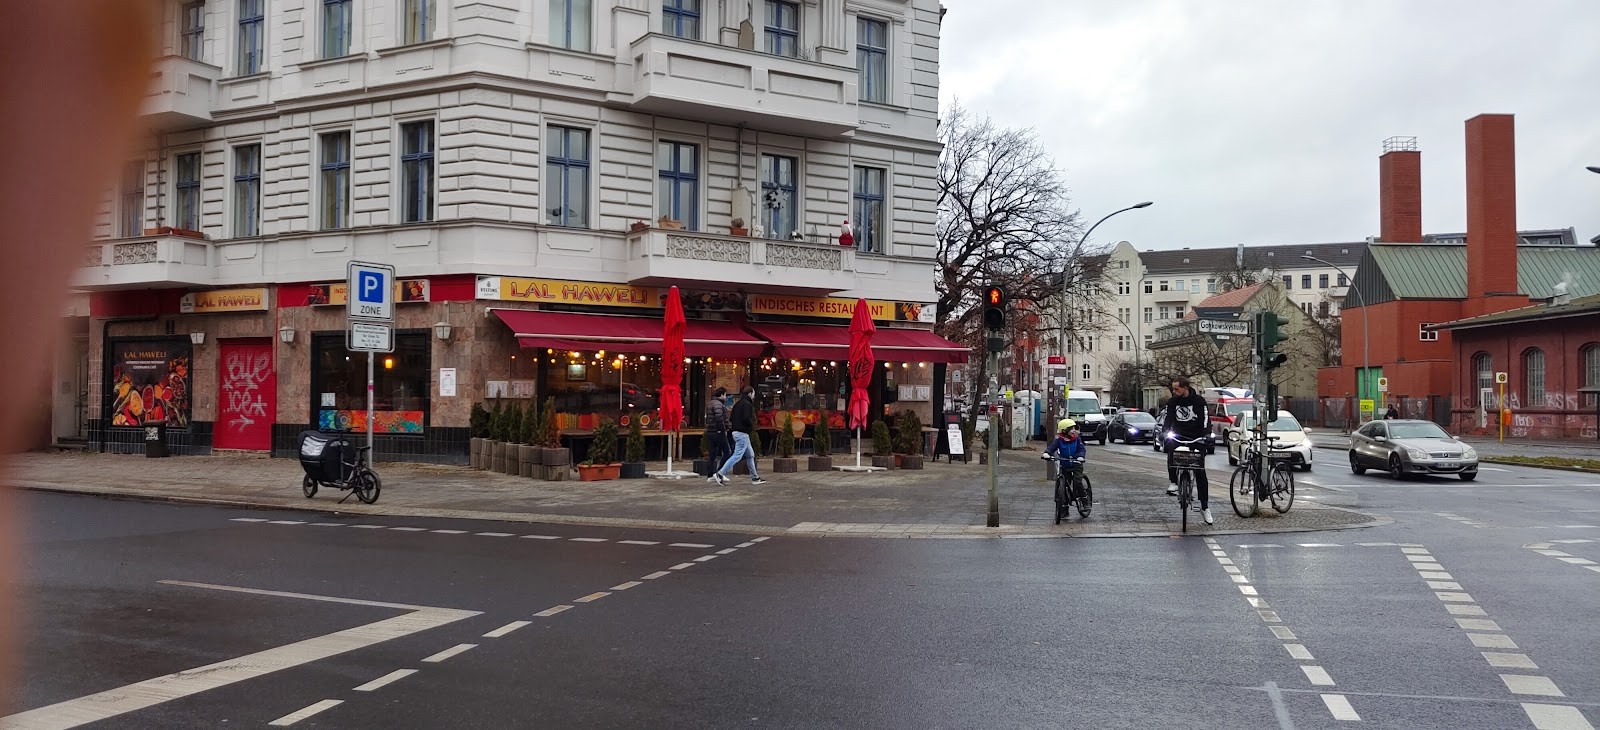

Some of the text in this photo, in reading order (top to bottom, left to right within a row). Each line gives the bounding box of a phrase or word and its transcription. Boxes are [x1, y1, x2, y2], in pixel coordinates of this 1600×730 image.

[364, 276, 378, 298] P
[510, 281, 648, 304] LAL HAWELI
[195, 297, 215, 308] LAL
[218, 294, 261, 307] HAWELI
[755, 299, 884, 316] INDISCHES RESTAUNT
[360, 305, 382, 315] ZONE
[124, 351, 138, 359] LAL
